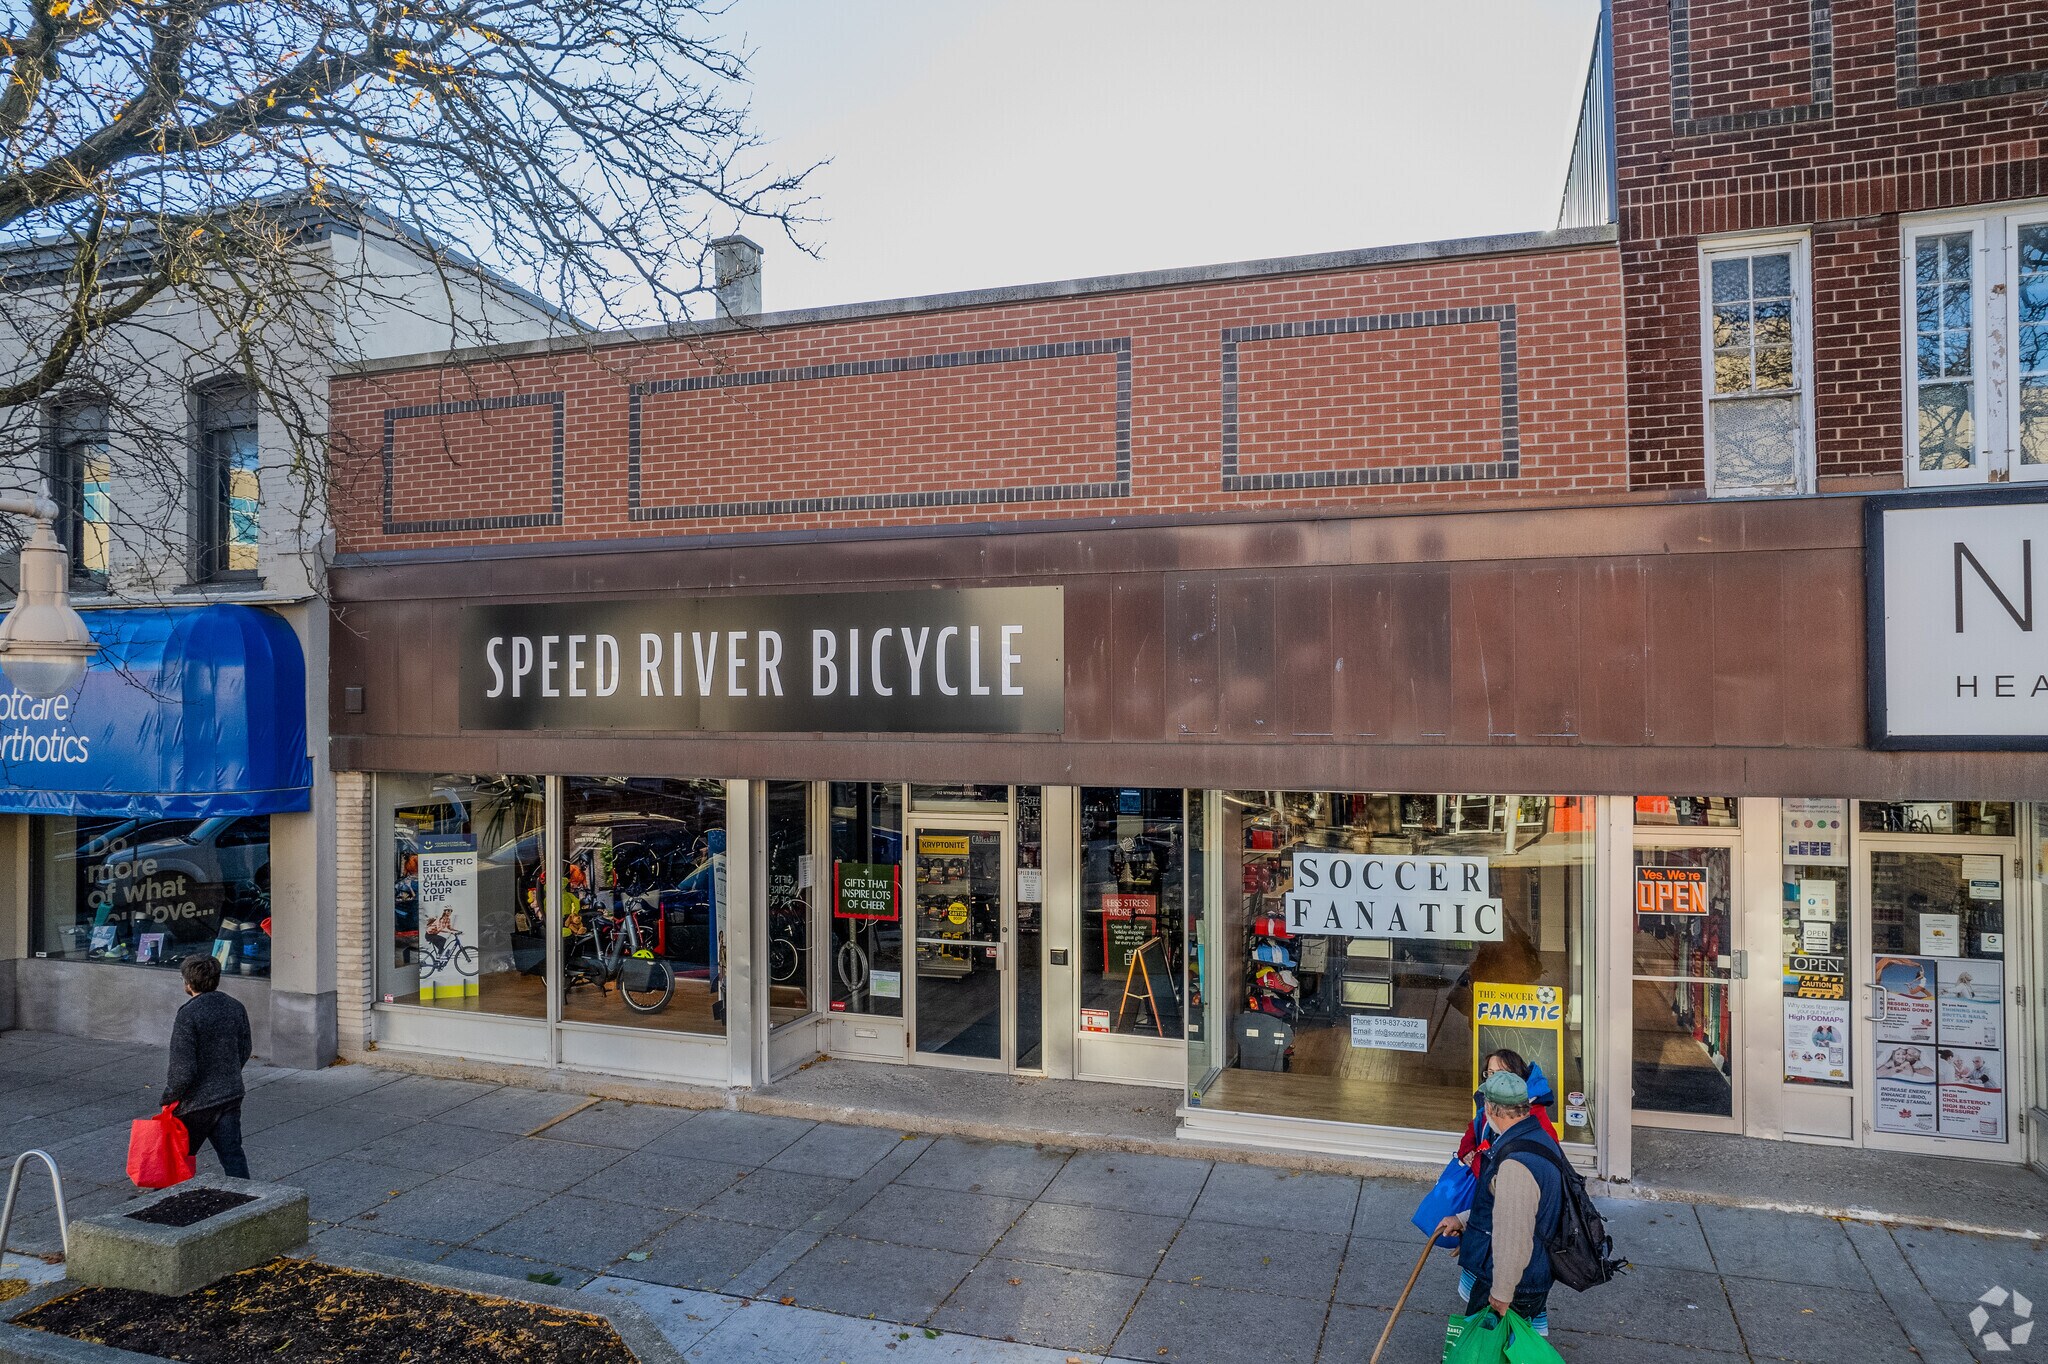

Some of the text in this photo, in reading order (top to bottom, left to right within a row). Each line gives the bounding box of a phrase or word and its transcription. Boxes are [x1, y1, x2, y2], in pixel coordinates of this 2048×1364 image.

[486, 625, 1024, 698] SPEED RIVER BICYCLE
[1956, 675, 2048, 697] HEA
[0, 726, 90, 763] rthotics
[88, 834, 128, 856] Do
[922, 841, 965, 849] KRYPTONITE
[423, 858, 473, 866] ELECTRIC
[88, 858, 158, 883] more
[1299, 858, 1482, 892] SOCCER
[1667, 869, 1701, 881] We're
[423, 880, 467, 888] CHANGE
[844, 878, 888, 889] GIFTS THAT
[87, 875, 187, 909] of what
[423, 887, 452, 895] YOUR
[842, 888, 891, 900] INSPIRE LOTS
[1637, 880, 1707, 912] OPEN
[424, 894, 445, 902] LIFE
[1106, 899, 1122, 907] LESS
[847, 900, 886, 910] OF CHEER
[1109, 908, 1132, 917] MORE
[1292, 899, 1497, 935] FANATIC
[1794, 957, 1839, 972] OPEN
[1801, 980, 1832, 988] CAUTION
[1478, 990, 1534, 1001] THE SOCCER
[1477, 1002, 1560, 1022] FANATIC
[1353, 1017, 1419, 1028] Phone: 519-837-3372
[1807, 1015, 1844, 1023] FODMAPs
[1353, 1027, 1426, 1039] Email: info@soccerfanatic.ca
[1942, 1097, 1991, 1106] CHOLESTEROL?
[1942, 1107, 1979, 1115] PRESSURE?
